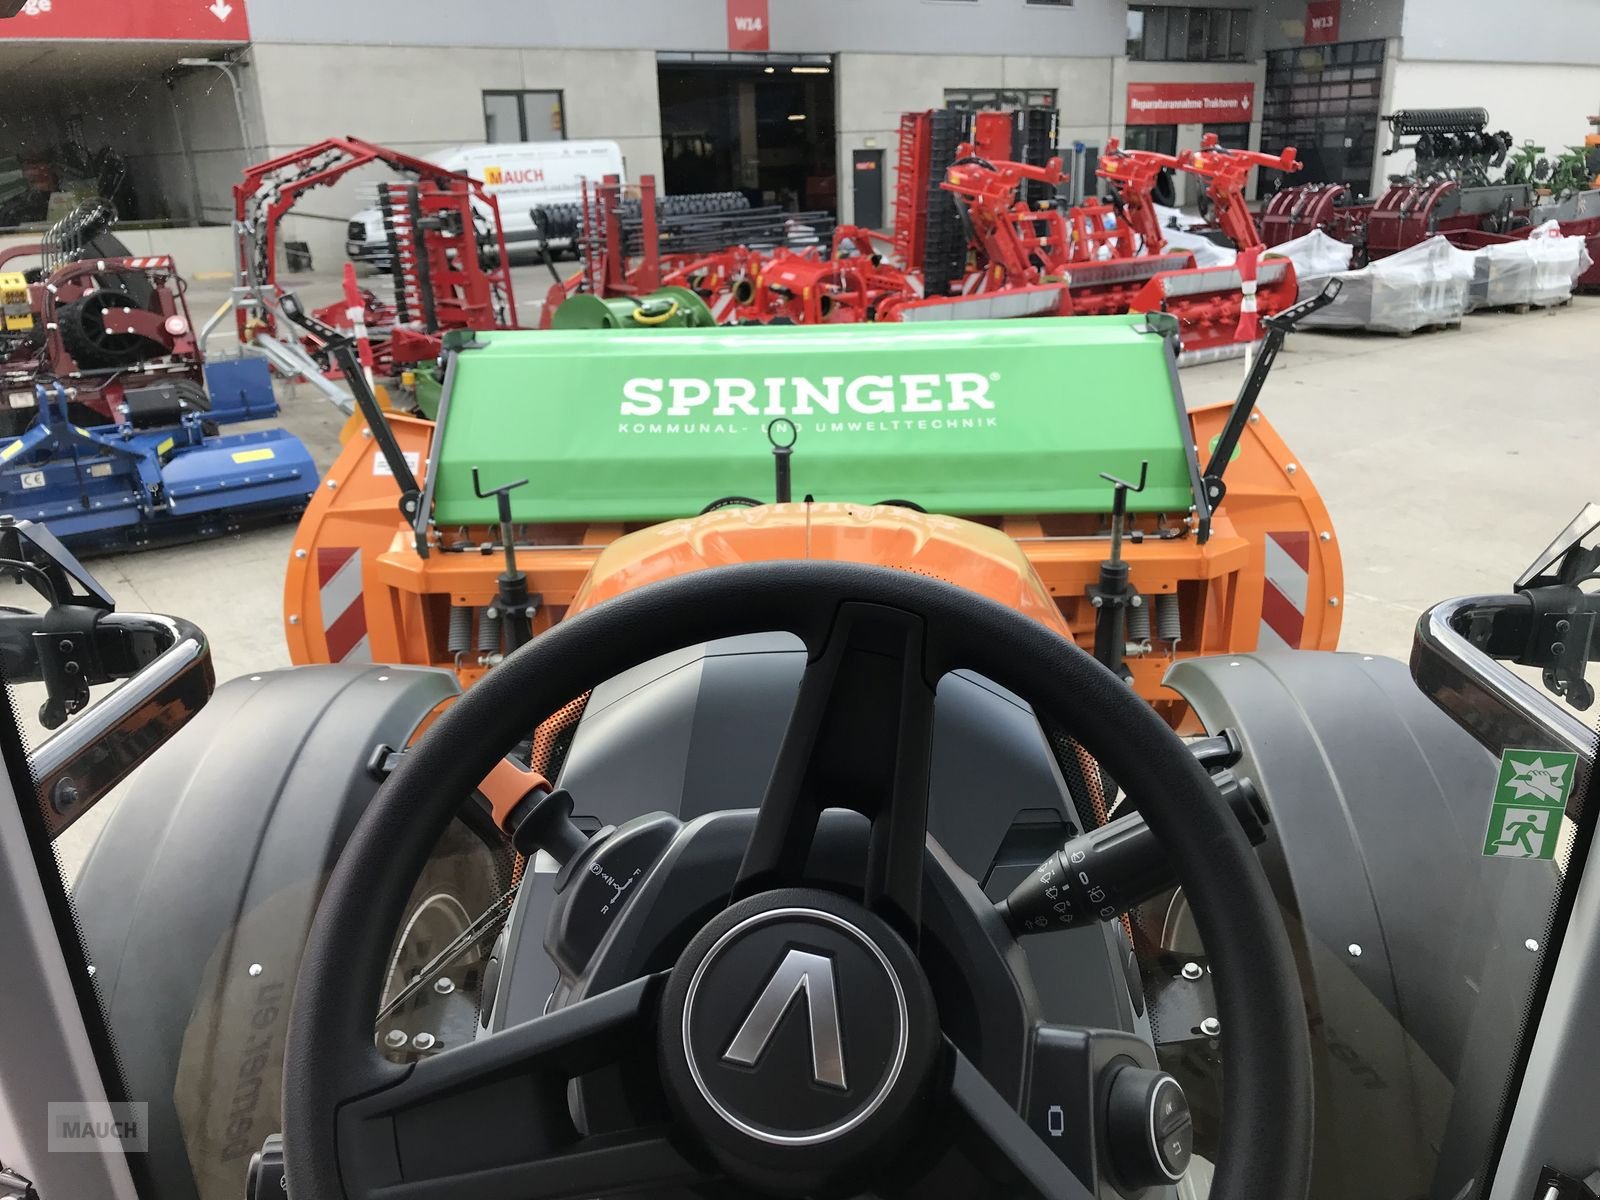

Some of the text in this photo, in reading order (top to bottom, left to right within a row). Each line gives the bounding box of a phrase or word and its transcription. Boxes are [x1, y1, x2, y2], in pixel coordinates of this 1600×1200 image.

[734, 16, 762, 31] W14
[489, 169, 544, 184] MAUCH
[618, 423, 748, 434] KOMMUNAL-
[816, 417, 997, 432] UMWELTTECHNIK
[600, 905, 609, 914] R
